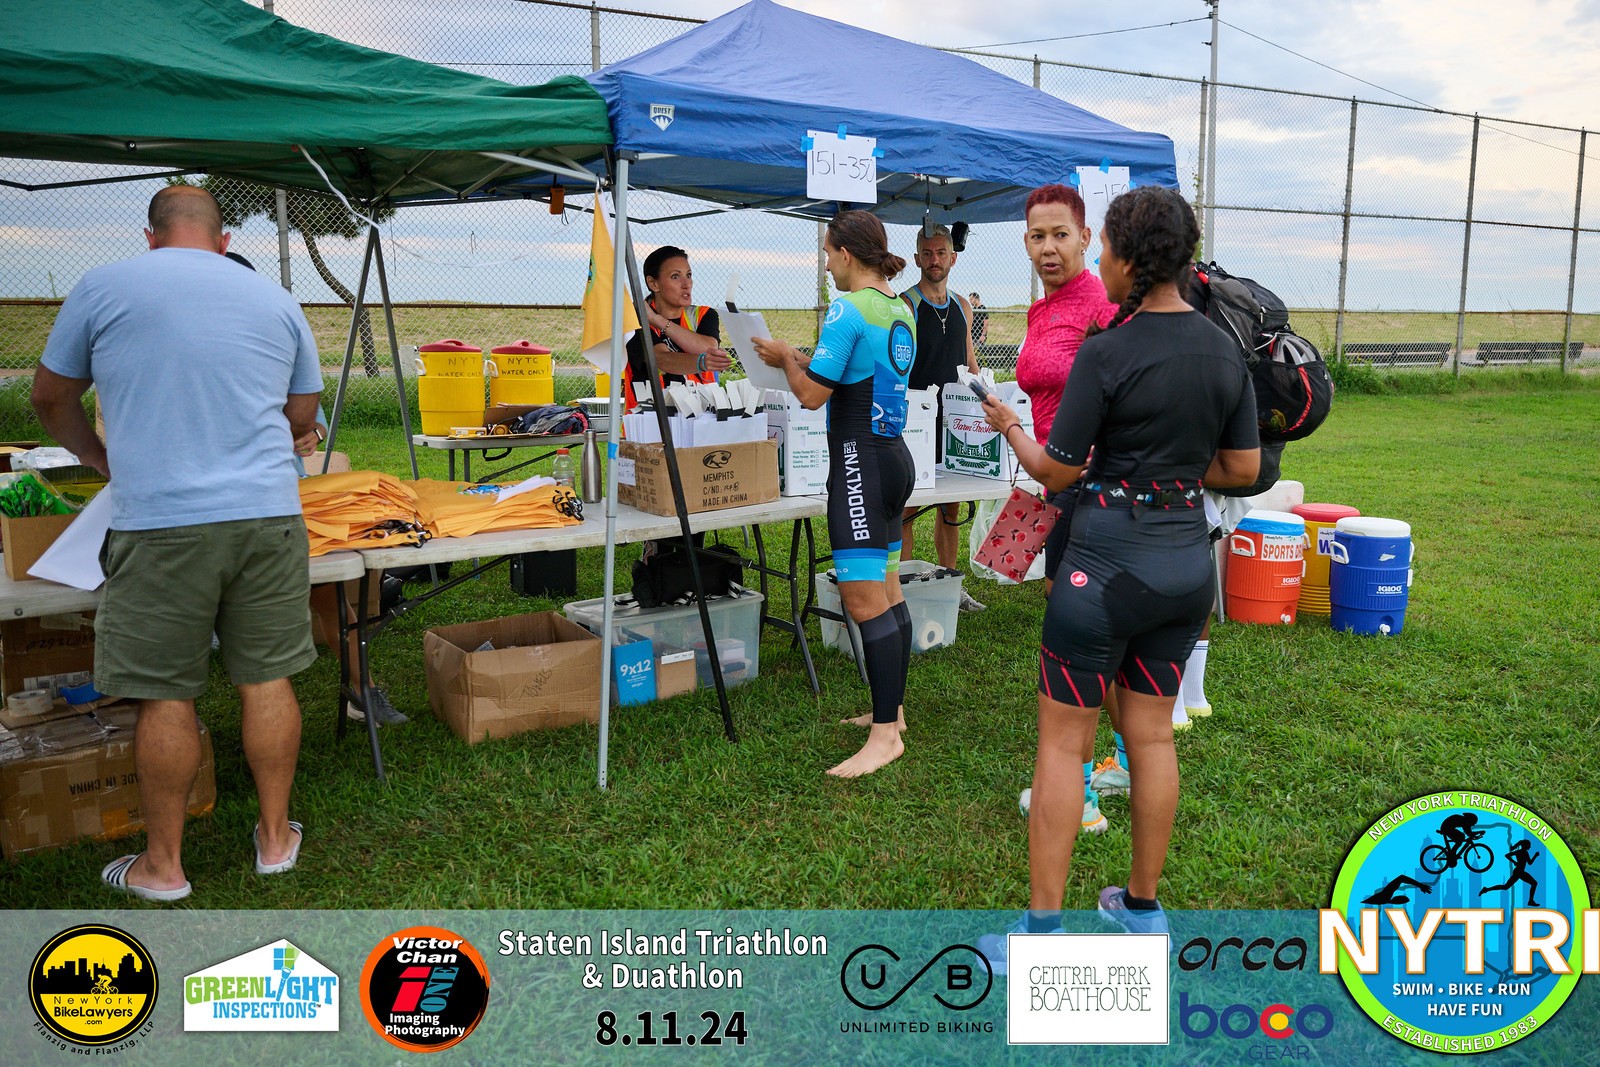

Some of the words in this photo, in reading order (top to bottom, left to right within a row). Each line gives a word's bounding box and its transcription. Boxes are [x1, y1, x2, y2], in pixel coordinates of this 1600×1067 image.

[653, 106, 672, 114] QUEST
[811, 150, 875, 183] 151-350
[895, 344, 911, 362] BTC
[507, 357, 538, 365] NYTC
[955, 394, 971, 402] FRESH
[768, 403, 784, 411] HEALTH
[953, 418, 973, 431] Farm
[702, 496, 720, 507] MADE
[721, 495, 729, 504] IN
[730, 492, 748, 503] CHINA
[844, 454, 870, 541] BROOKLYN
[1263, 543, 1294, 559] SPORTS
[620, 659, 651, 676] 9x12
[69, 779, 100, 795] CHINA
[105, 776, 116, 787] IN
